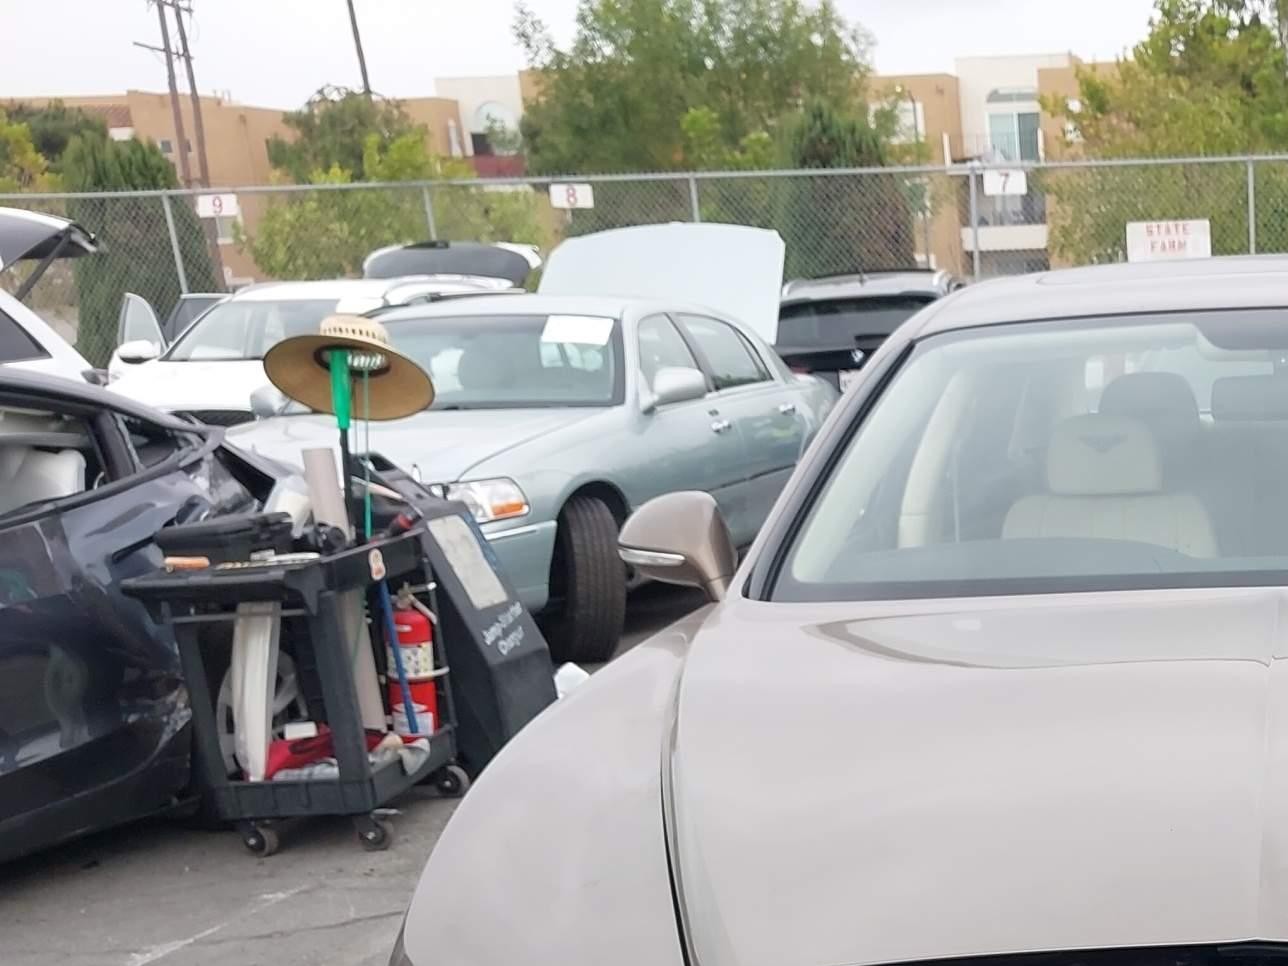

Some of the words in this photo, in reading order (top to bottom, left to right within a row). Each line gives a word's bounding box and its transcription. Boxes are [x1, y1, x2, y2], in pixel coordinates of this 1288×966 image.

[998, 170, 1009, 193] 7
[212, 195, 223, 216] 9
[566, 184, 578, 207] 8
[1145, 223, 1192, 237] STATE
